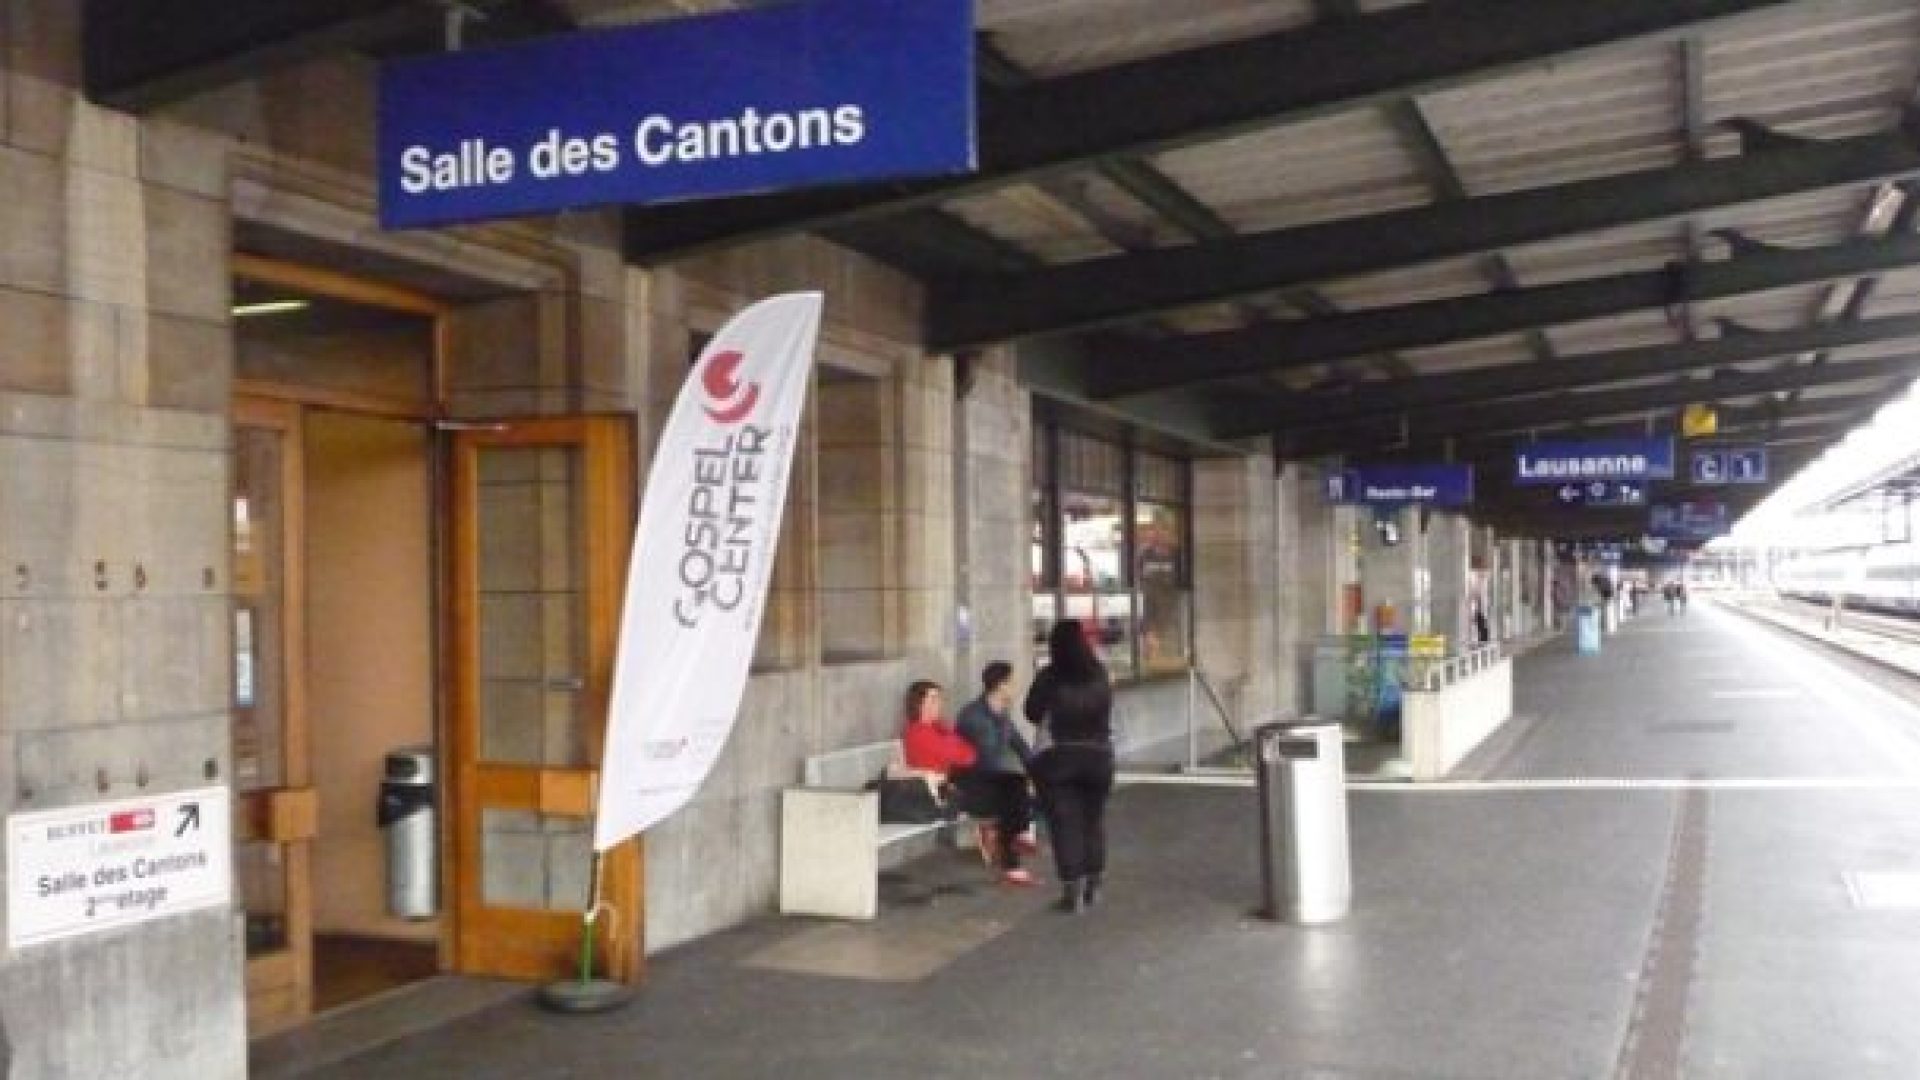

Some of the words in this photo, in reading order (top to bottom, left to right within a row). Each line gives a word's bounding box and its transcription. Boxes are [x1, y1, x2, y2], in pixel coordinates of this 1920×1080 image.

[400, 140, 513, 193] Salle
[528, 129, 619, 178] des
[635, 104, 864, 165] Cantons
[1517, 452, 1648, 479] Lausanne
[673, 432, 735, 628] GOSPEL
[710, 423, 773, 613] CENTER
[37, 873, 88, 898] Salle
[93, 864, 129, 886] des
